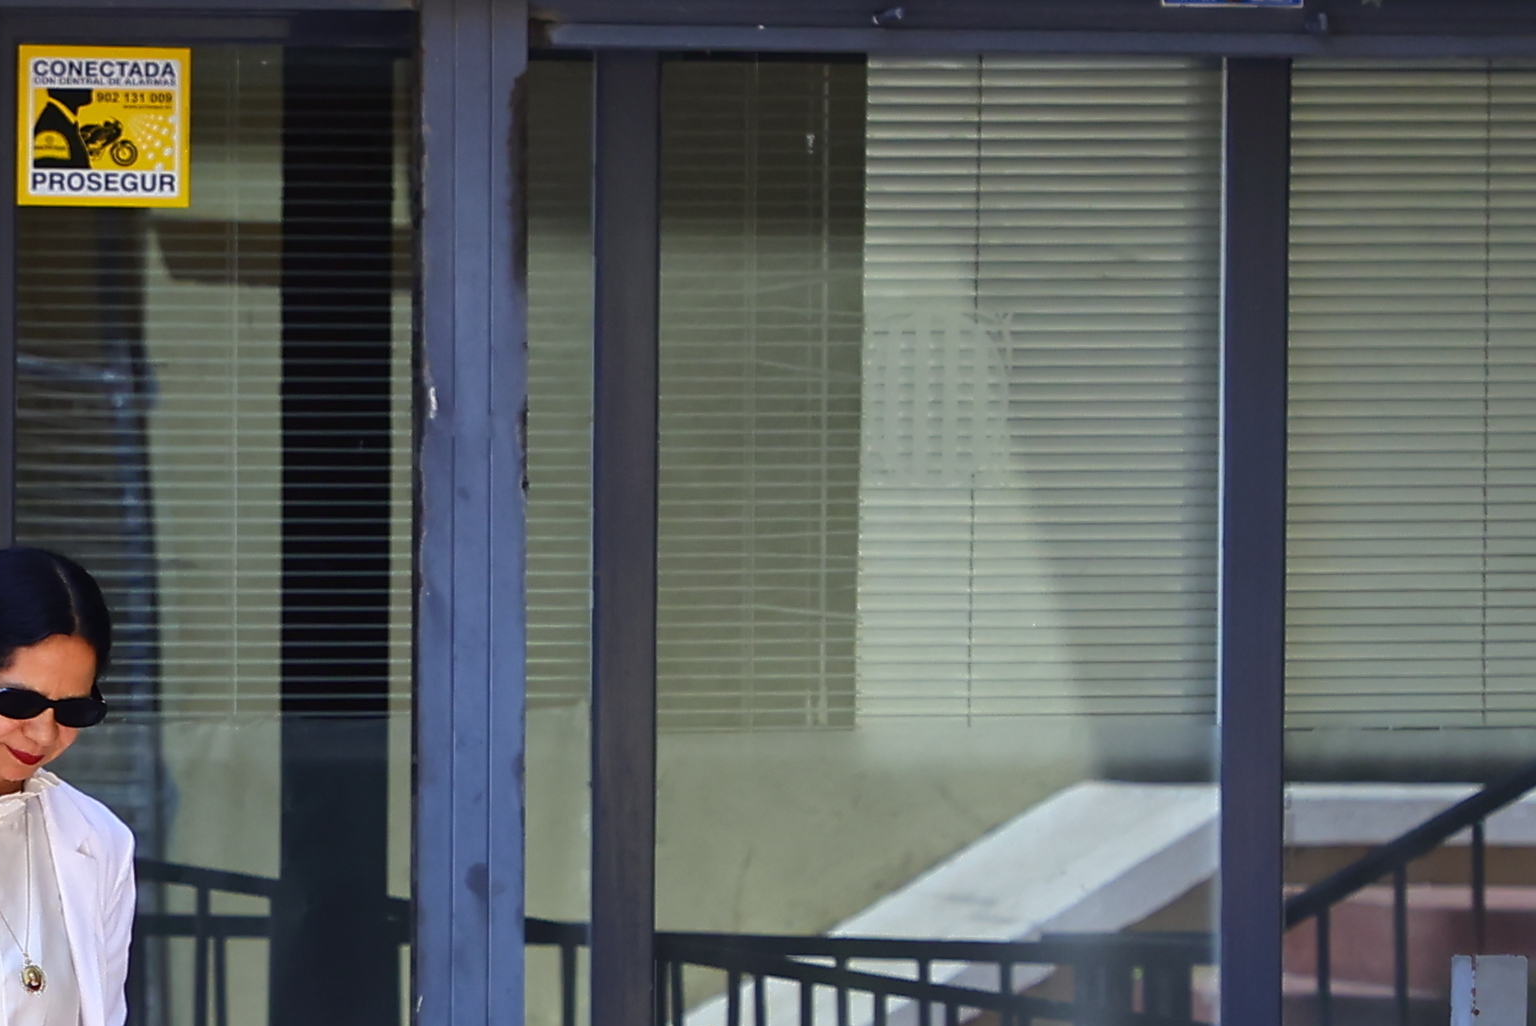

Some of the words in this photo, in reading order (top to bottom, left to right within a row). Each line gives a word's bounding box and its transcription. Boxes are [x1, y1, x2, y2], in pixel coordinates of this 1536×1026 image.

[33, 60, 176, 78] CONECTADA
[34, 77, 56, 85] CON
[59, 77, 105, 86] CENTRAL
[124, 77, 176, 87] ALARMAS
[96, 92, 120, 103] 902
[124, 93, 146, 103] 131
[150, 93, 173, 103] 009
[31, 172, 176, 192] PROSEGUR
